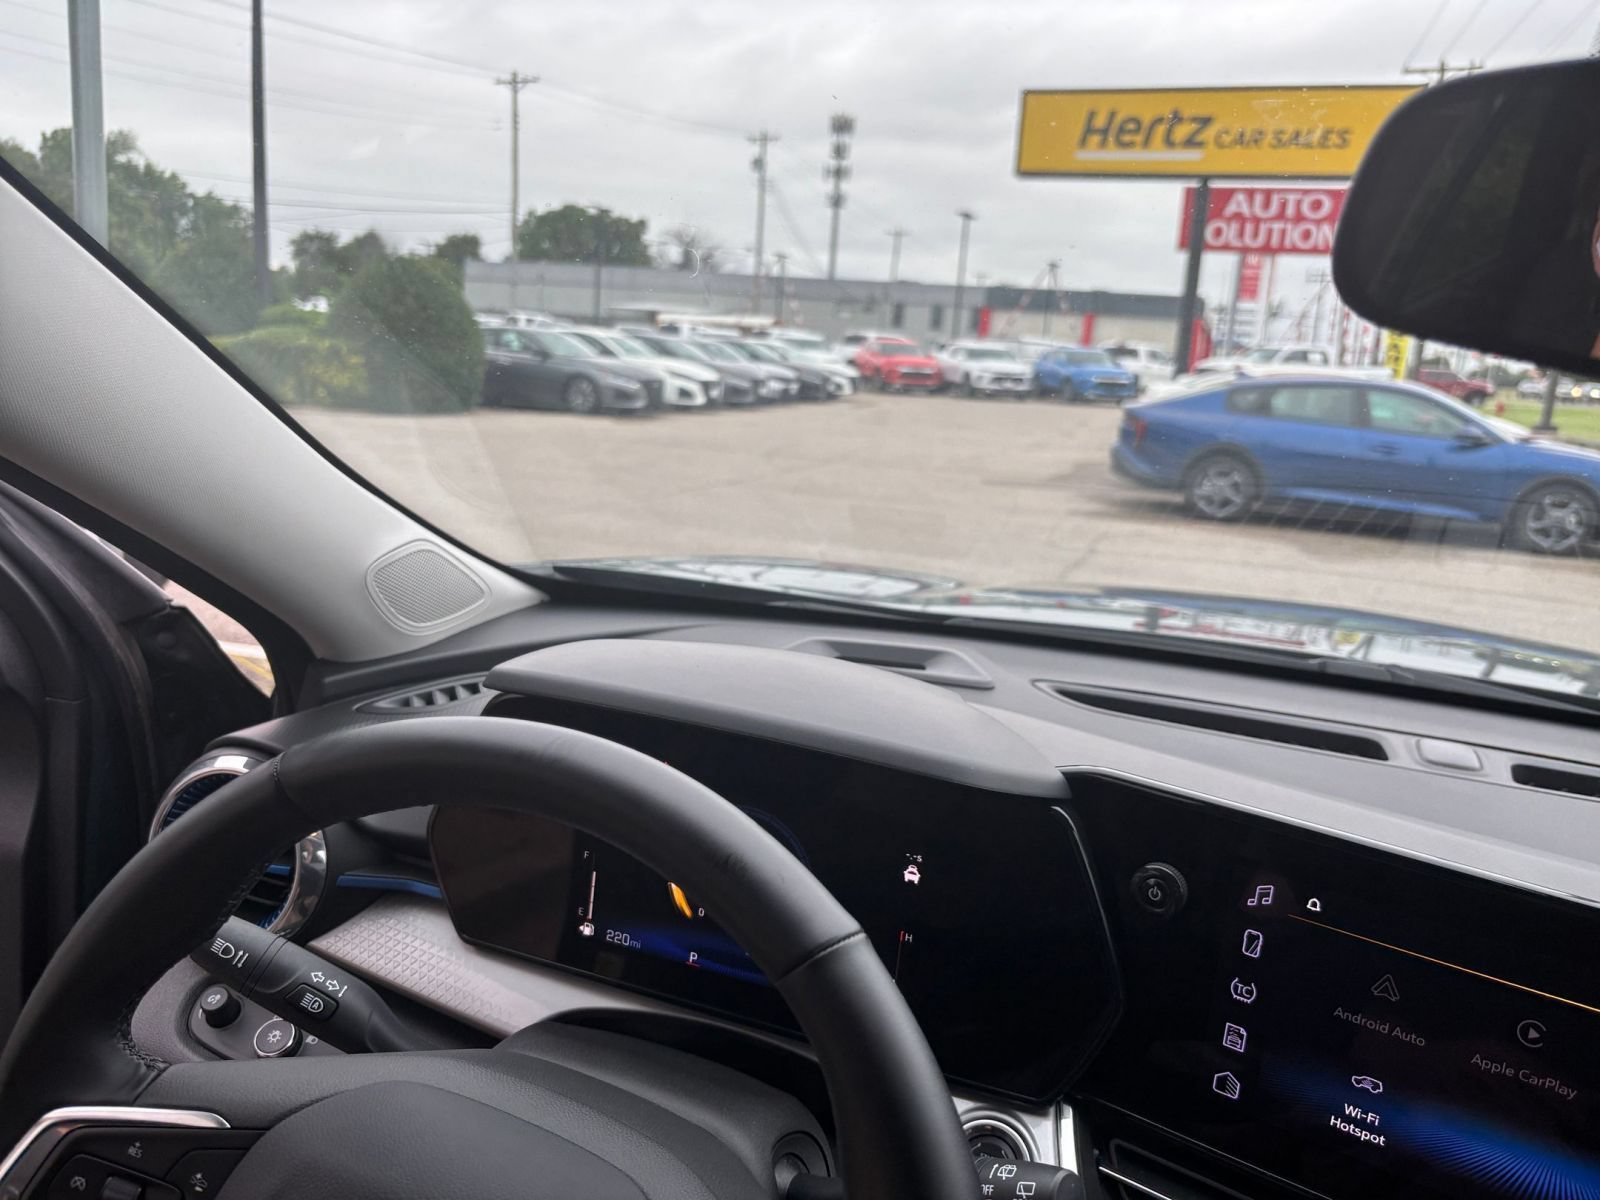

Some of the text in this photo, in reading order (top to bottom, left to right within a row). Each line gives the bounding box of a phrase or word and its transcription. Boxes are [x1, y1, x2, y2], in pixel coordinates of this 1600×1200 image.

[1076, 106, 1352, 150] Hertz CAR SALES
[1222, 191, 1334, 219] AUTO
[1203, 219, 1337, 250] OLUTION
[583, 850, 590, 860] F
[578, 907, 585, 917] E
[905, 932, 913, 943] H
[689, 951, 698, 964] P
[1235, 982, 1252, 998] TC
[1332, 1006, 1425, 1047] Android Auto
[1470, 1053, 1578, 1100] Apple CarPlay
[1344, 1103, 1380, 1127] Wi-Fi
[1329, 1115, 1387, 1147] Hotspot
